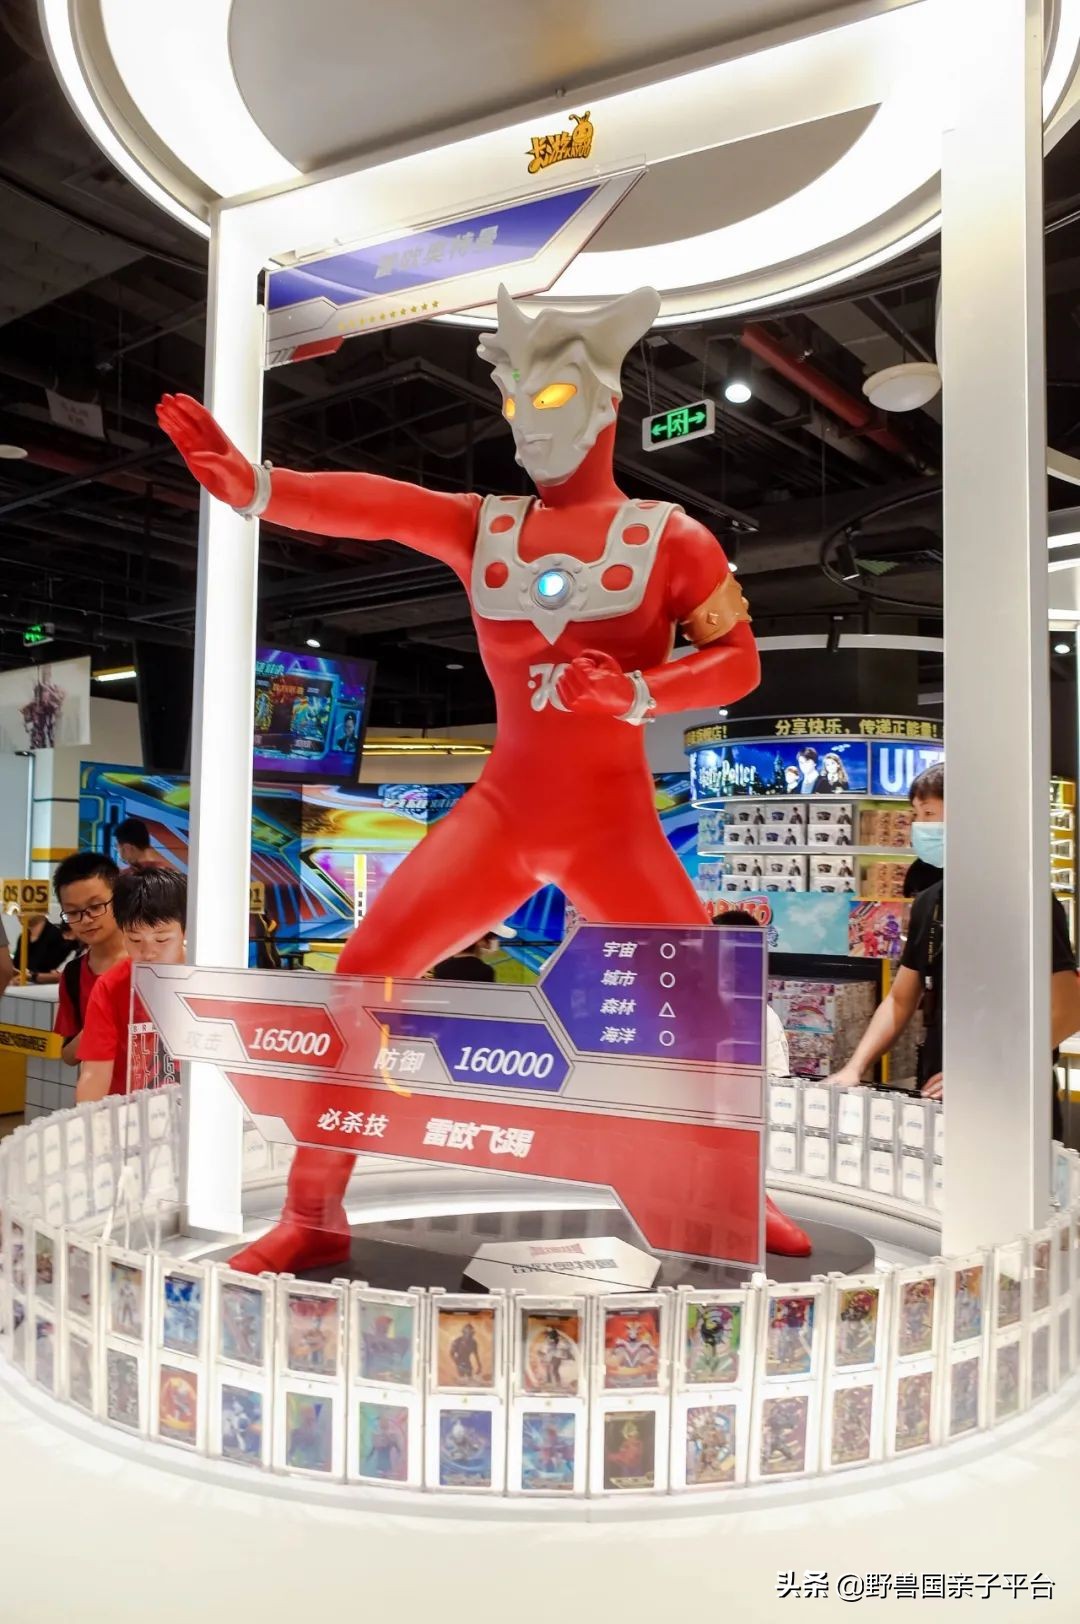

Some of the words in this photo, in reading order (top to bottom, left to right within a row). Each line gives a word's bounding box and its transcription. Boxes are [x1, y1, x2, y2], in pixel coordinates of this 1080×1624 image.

[880, 748, 944, 793] ULT
[22, 885, 48, 903] 05
[602, 941, 638, 958] 宇宙
[601, 969, 638, 987] 城市
[600, 998, 637, 1016] 森林
[185, 1029, 224, 1051] 攻击
[249, 1027, 331, 1056] 165000
[600, 1026, 637, 1045] 海洋
[373, 1047, 426, 1073] 防御
[454, 1046, 555, 1079] 160000
[317, 1108, 390, 1138] 必杀技
[423, 1117, 535, 1159] 雷欧飞踢
